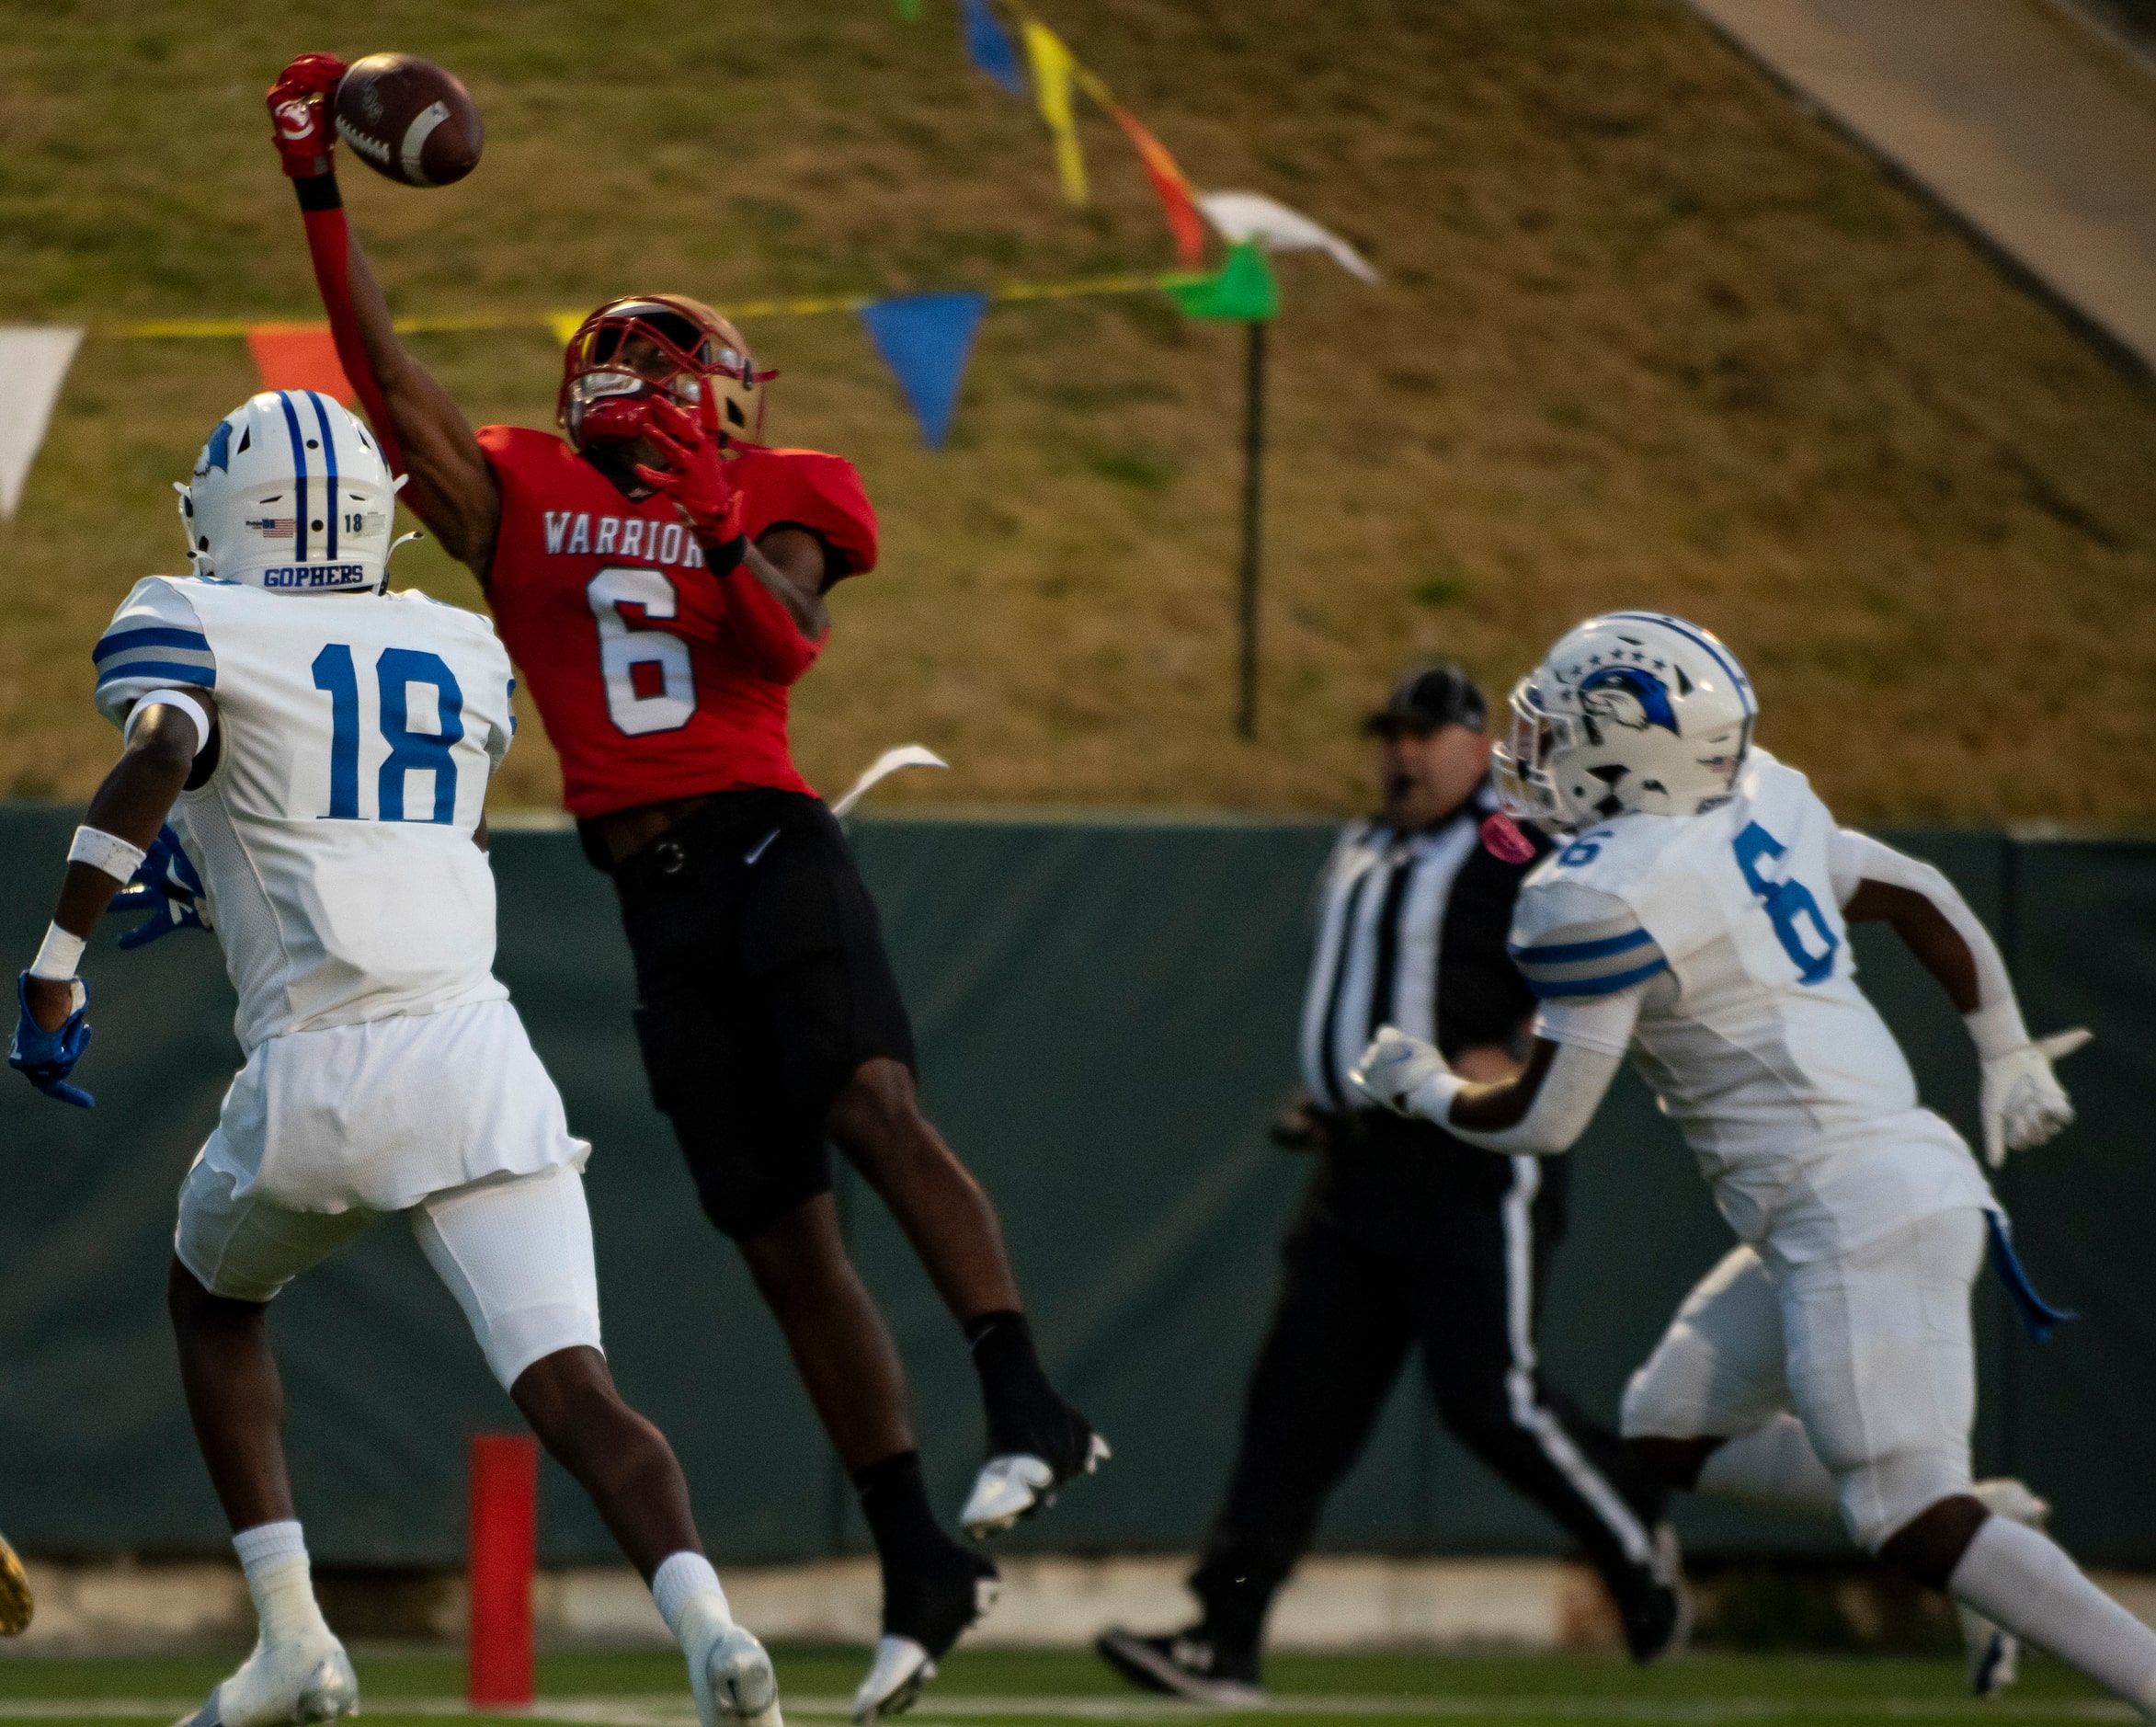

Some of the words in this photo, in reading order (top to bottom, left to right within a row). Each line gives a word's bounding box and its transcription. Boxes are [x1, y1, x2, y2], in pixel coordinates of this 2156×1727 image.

[264, 565, 363, 588] GOPHERS
[345, 513, 362, 533] 18
[311, 643, 465, 825] 18
[586, 565, 698, 738] 6
[1732, 819, 1840, 987] 6
